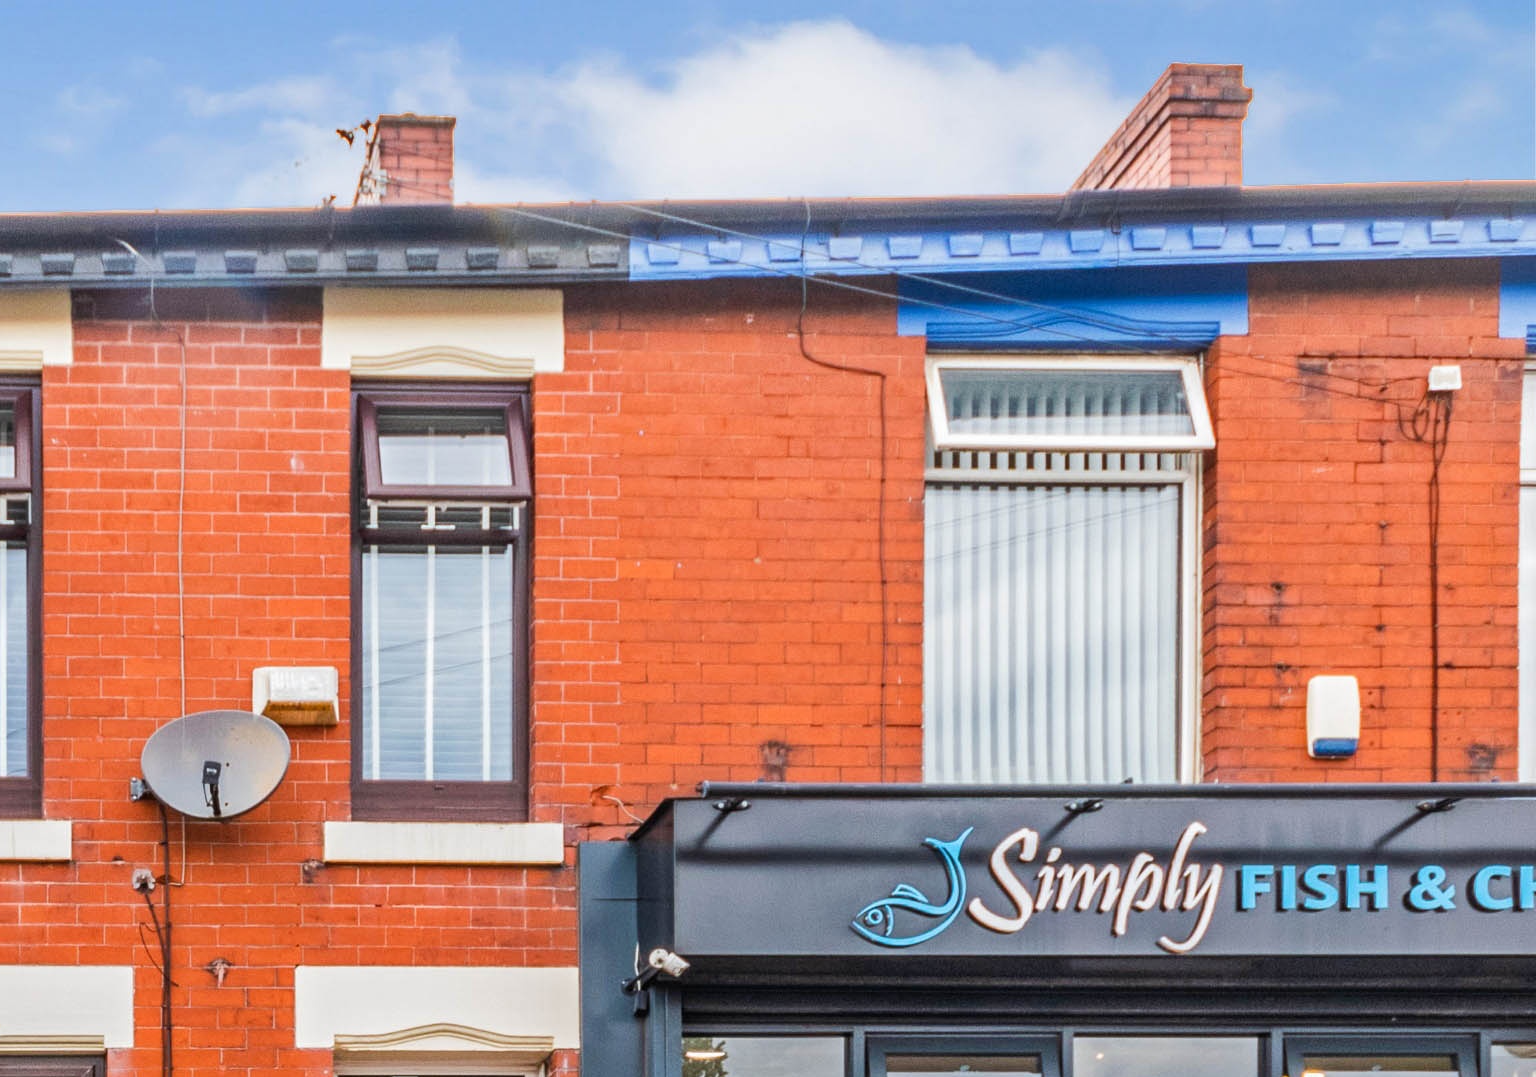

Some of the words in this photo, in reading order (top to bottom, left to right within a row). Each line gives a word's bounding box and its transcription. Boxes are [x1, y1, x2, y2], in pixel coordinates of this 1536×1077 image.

[967, 821, 1223, 953] Simply
[1240, 865, 1389, 911] FISH
[1414, 864, 1457, 911] &
